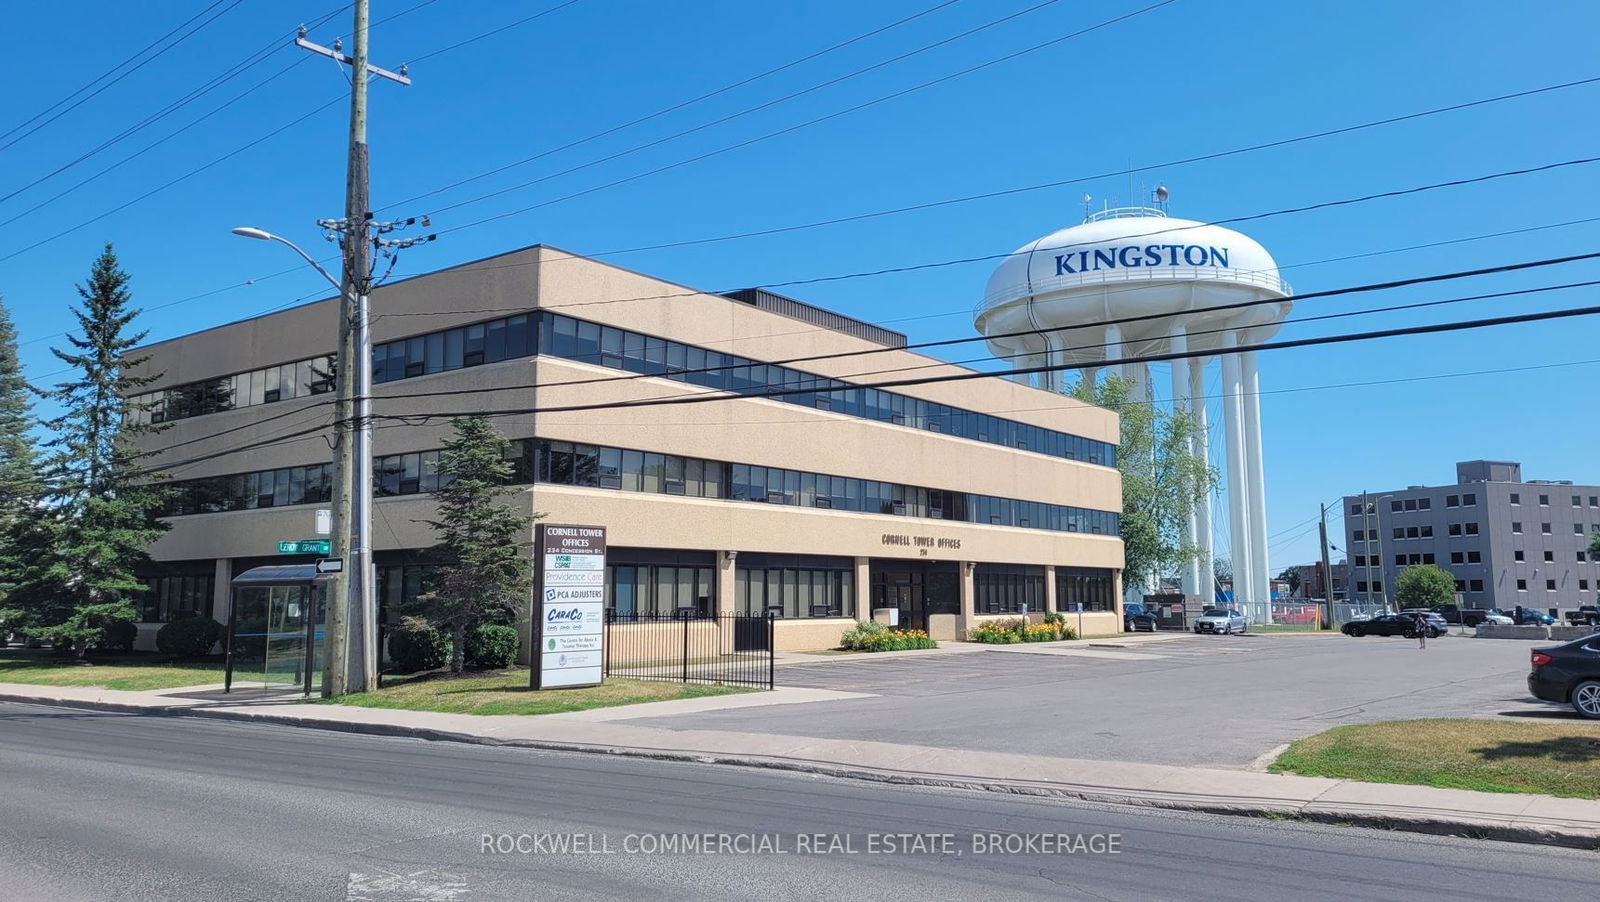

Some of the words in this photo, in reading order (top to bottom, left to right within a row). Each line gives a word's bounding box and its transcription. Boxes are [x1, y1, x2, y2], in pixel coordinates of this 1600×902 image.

[1055, 245, 1229, 276] KINGSTON
[547, 527, 578, 537] CORNELL
[579, 528, 603, 537] TOWER
[562, 538, 589, 547] OFFICES
[882, 534, 910, 546] CORNELL
[913, 535, 935, 547] TOWER
[937, 537, 961, 549] OFFICES
[280, 543, 298, 552] LEROY
[301, 543, 320, 552] GRANT
[545, 572, 586, 581] Providence
[587, 573, 603, 581] Care
[556, 590, 569, 599] PCA
[570, 590, 602, 599] ADJUSTERS
